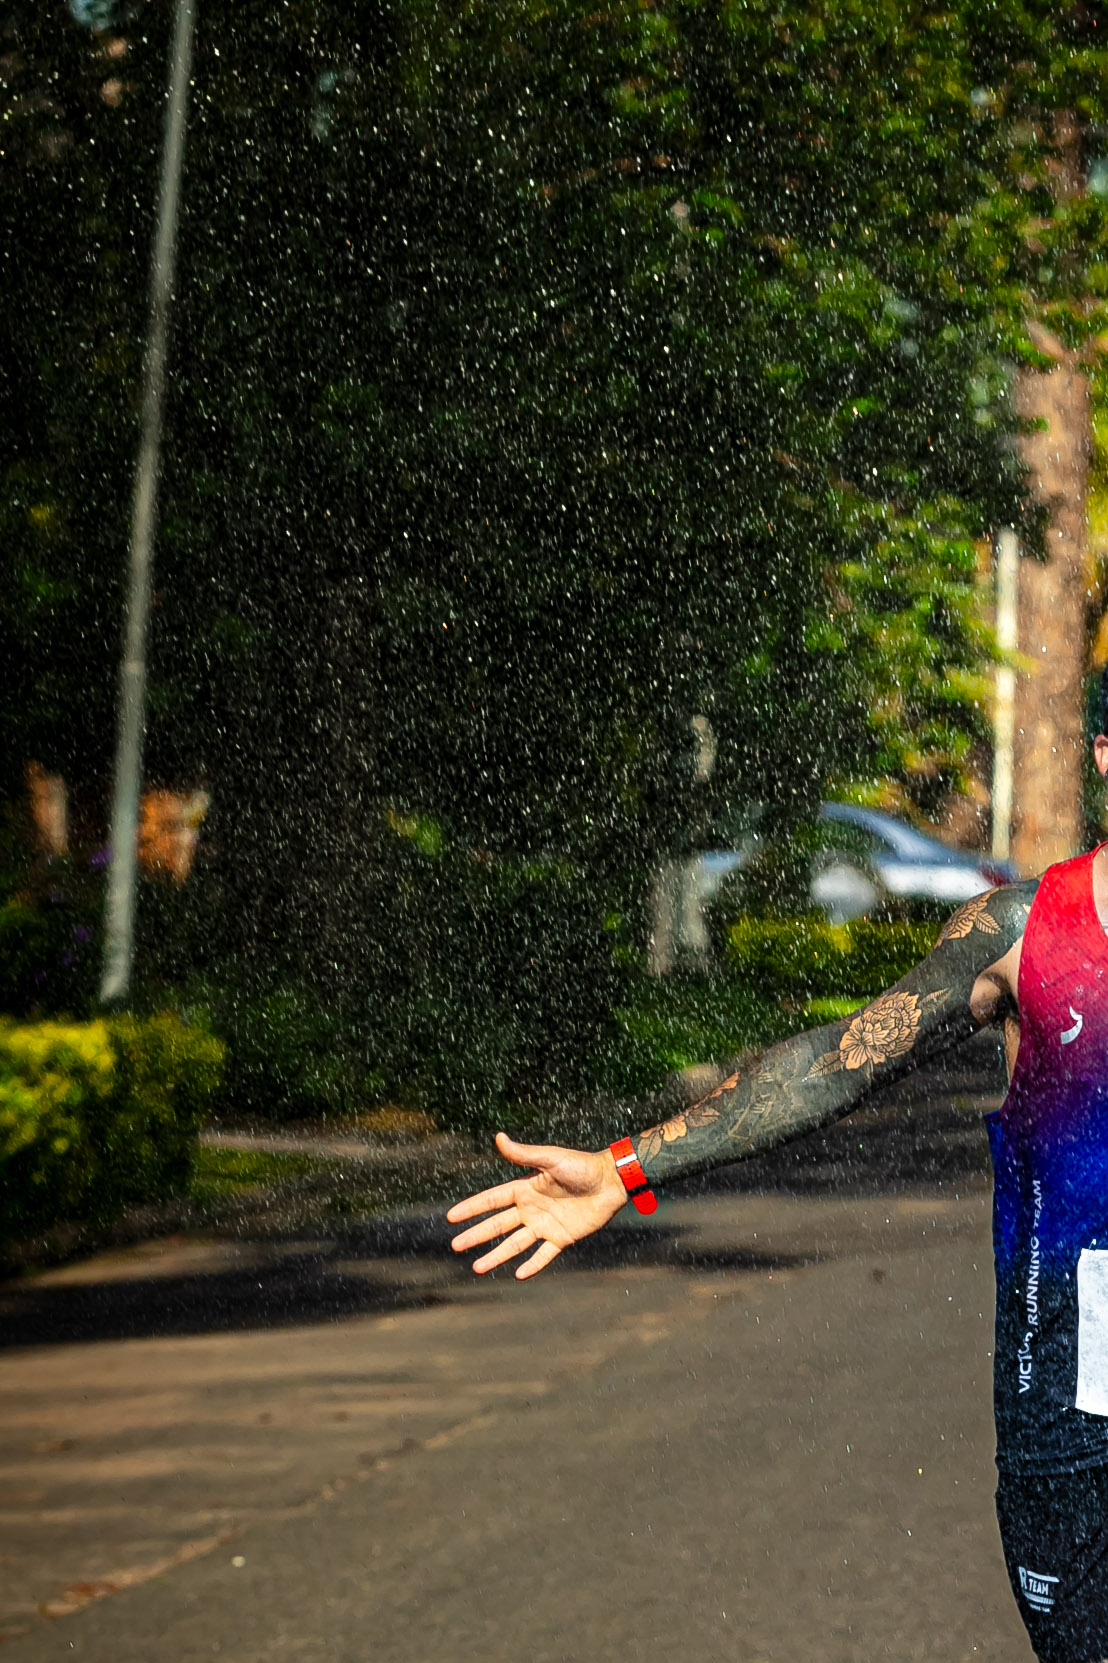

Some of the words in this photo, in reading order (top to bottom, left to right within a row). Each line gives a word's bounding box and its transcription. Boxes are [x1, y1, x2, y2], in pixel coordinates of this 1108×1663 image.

[1032, 1179, 1043, 1230] TEAM
[1026, 1236, 1040, 1326] RUNNING
[1029, 1578, 1049, 1596] TEAM
